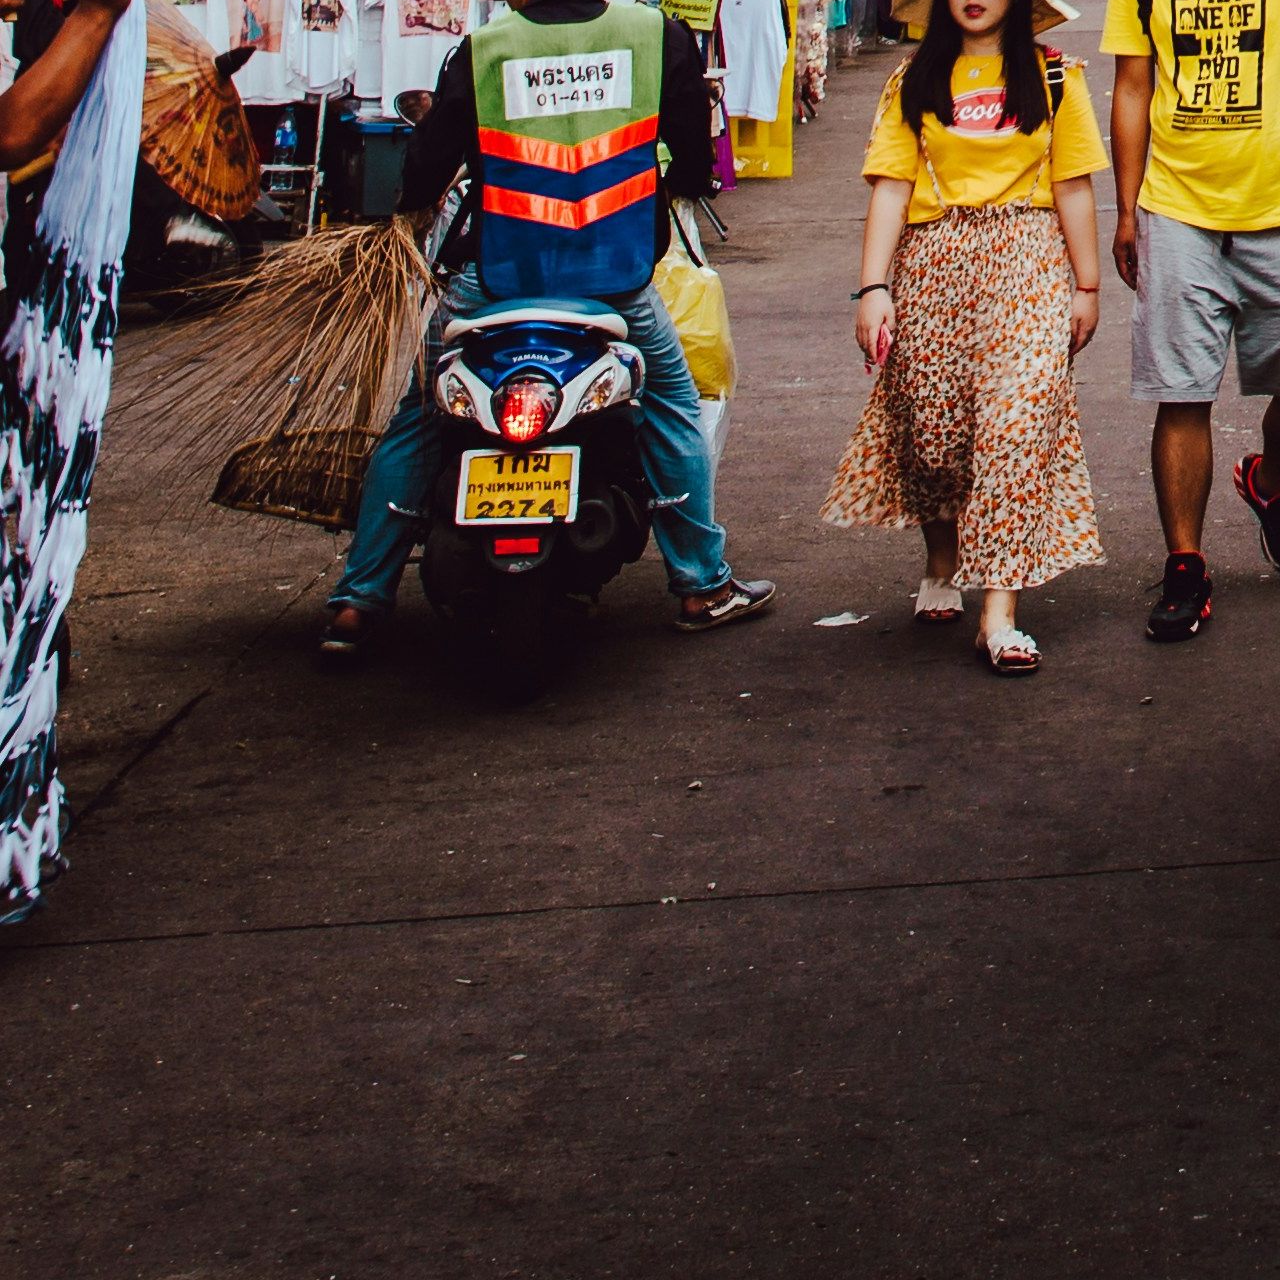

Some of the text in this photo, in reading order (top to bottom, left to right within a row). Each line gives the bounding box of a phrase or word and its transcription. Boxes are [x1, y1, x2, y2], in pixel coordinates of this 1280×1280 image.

[1179, 4, 1255, 31] ONE OF
[525, 62, 614, 88] พระนคร
[536, 88, 605, 107] 01-419
[1191, 81, 1241, 105] FIVE
[512, 353, 550, 363] YAMAHA
[467, 480, 570, 497] กรุงเทพมหานคร
[475, 498, 556, 519] 2274
